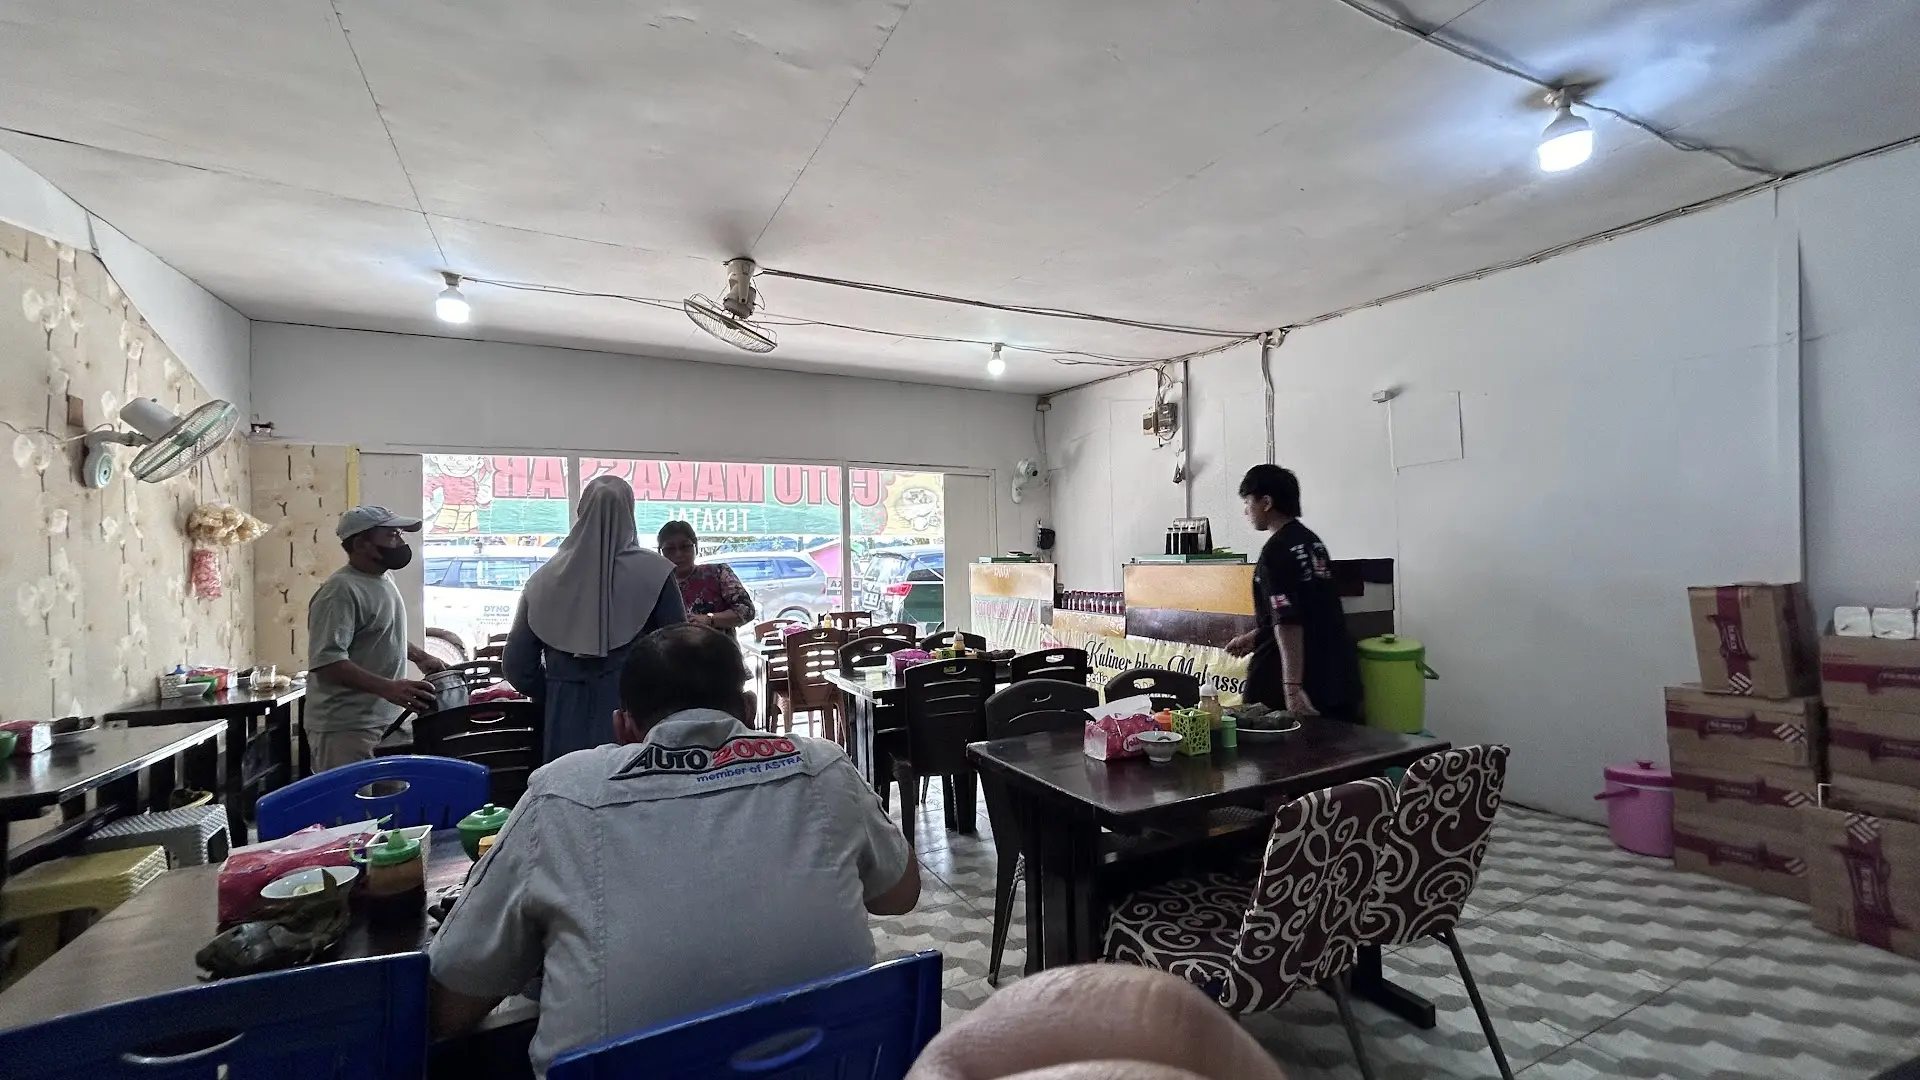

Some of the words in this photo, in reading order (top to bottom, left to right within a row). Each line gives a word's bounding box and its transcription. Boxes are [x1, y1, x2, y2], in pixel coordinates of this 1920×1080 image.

[1085, 640, 1132, 671] Kuliner
[618, 745, 708, 774] AUTO
[712, 737, 796, 769] 2000
[696, 767, 748, 783] member
[748, 762, 762, 774] of
[764, 755, 804, 772] ASTRA
